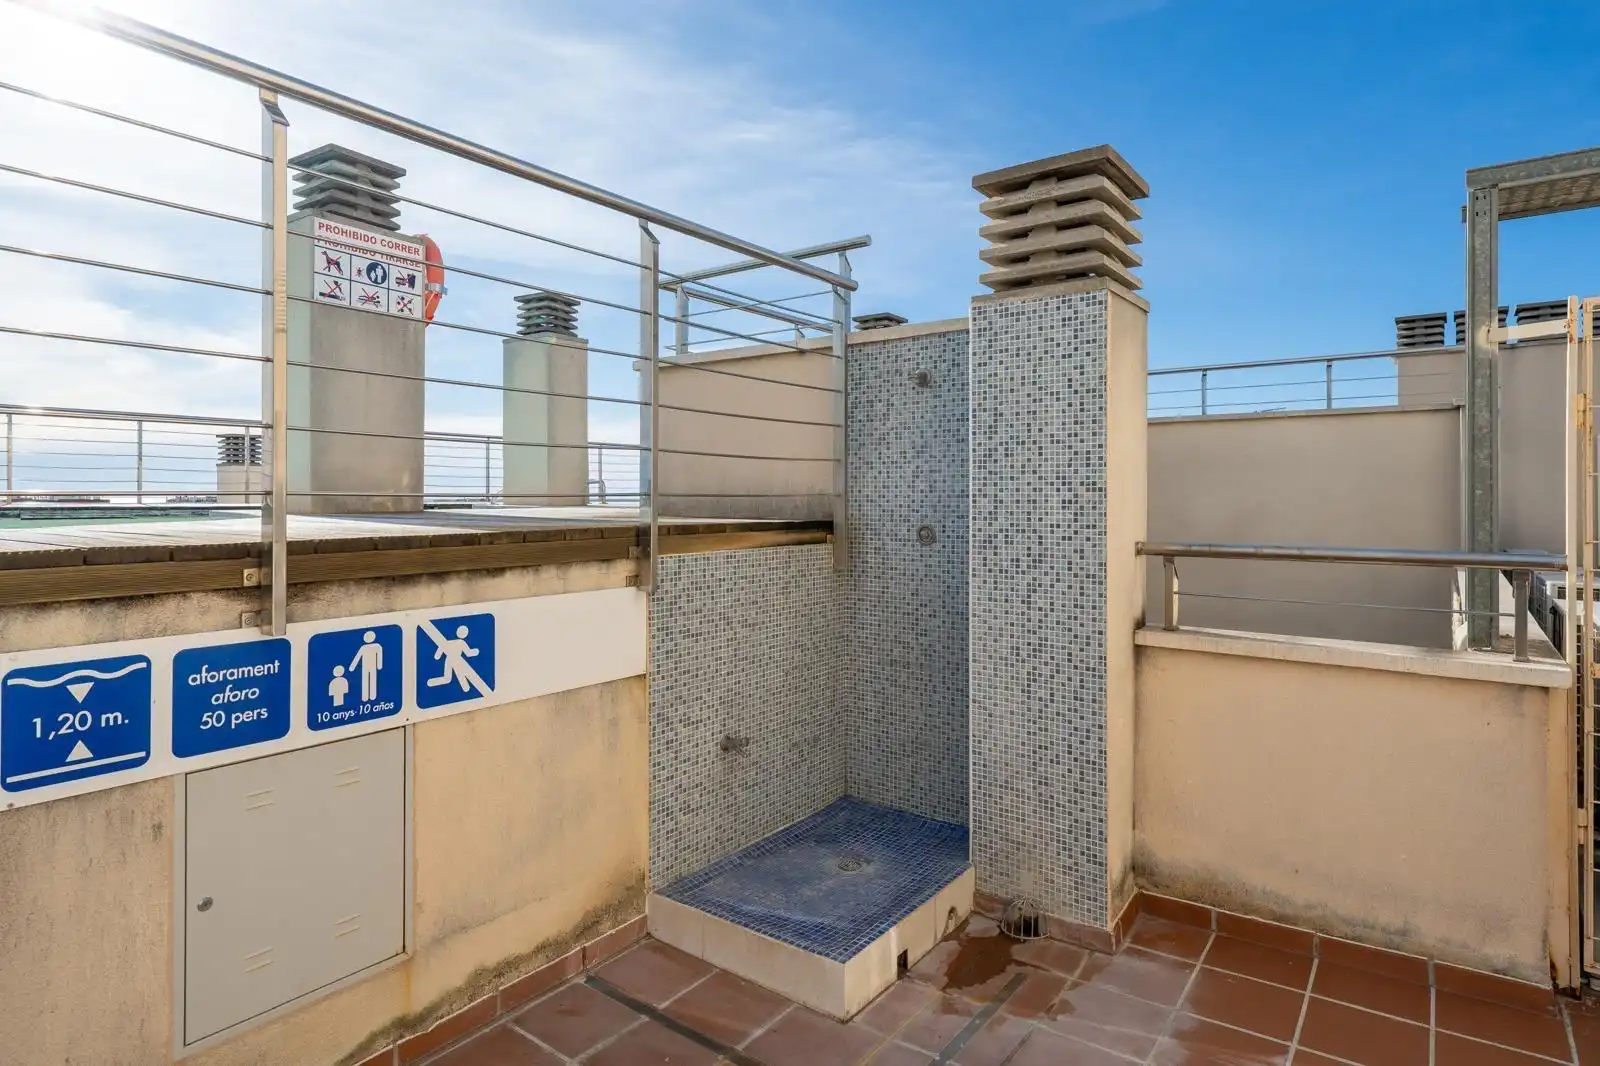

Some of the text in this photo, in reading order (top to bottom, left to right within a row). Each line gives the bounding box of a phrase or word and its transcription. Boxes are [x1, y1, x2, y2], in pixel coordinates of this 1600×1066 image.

[318, 221, 420, 256] PROHIBIDO CORRER
[188, 659, 280, 686] aforament
[211, 684, 260, 705] aforo
[200, 707, 268, 730] 50 pers
[317, 711, 330, 724] 10
[359, 703, 371, 715] 10
[372, 701, 395, 713] años
[32, 710, 129, 741] 1,20 m.
